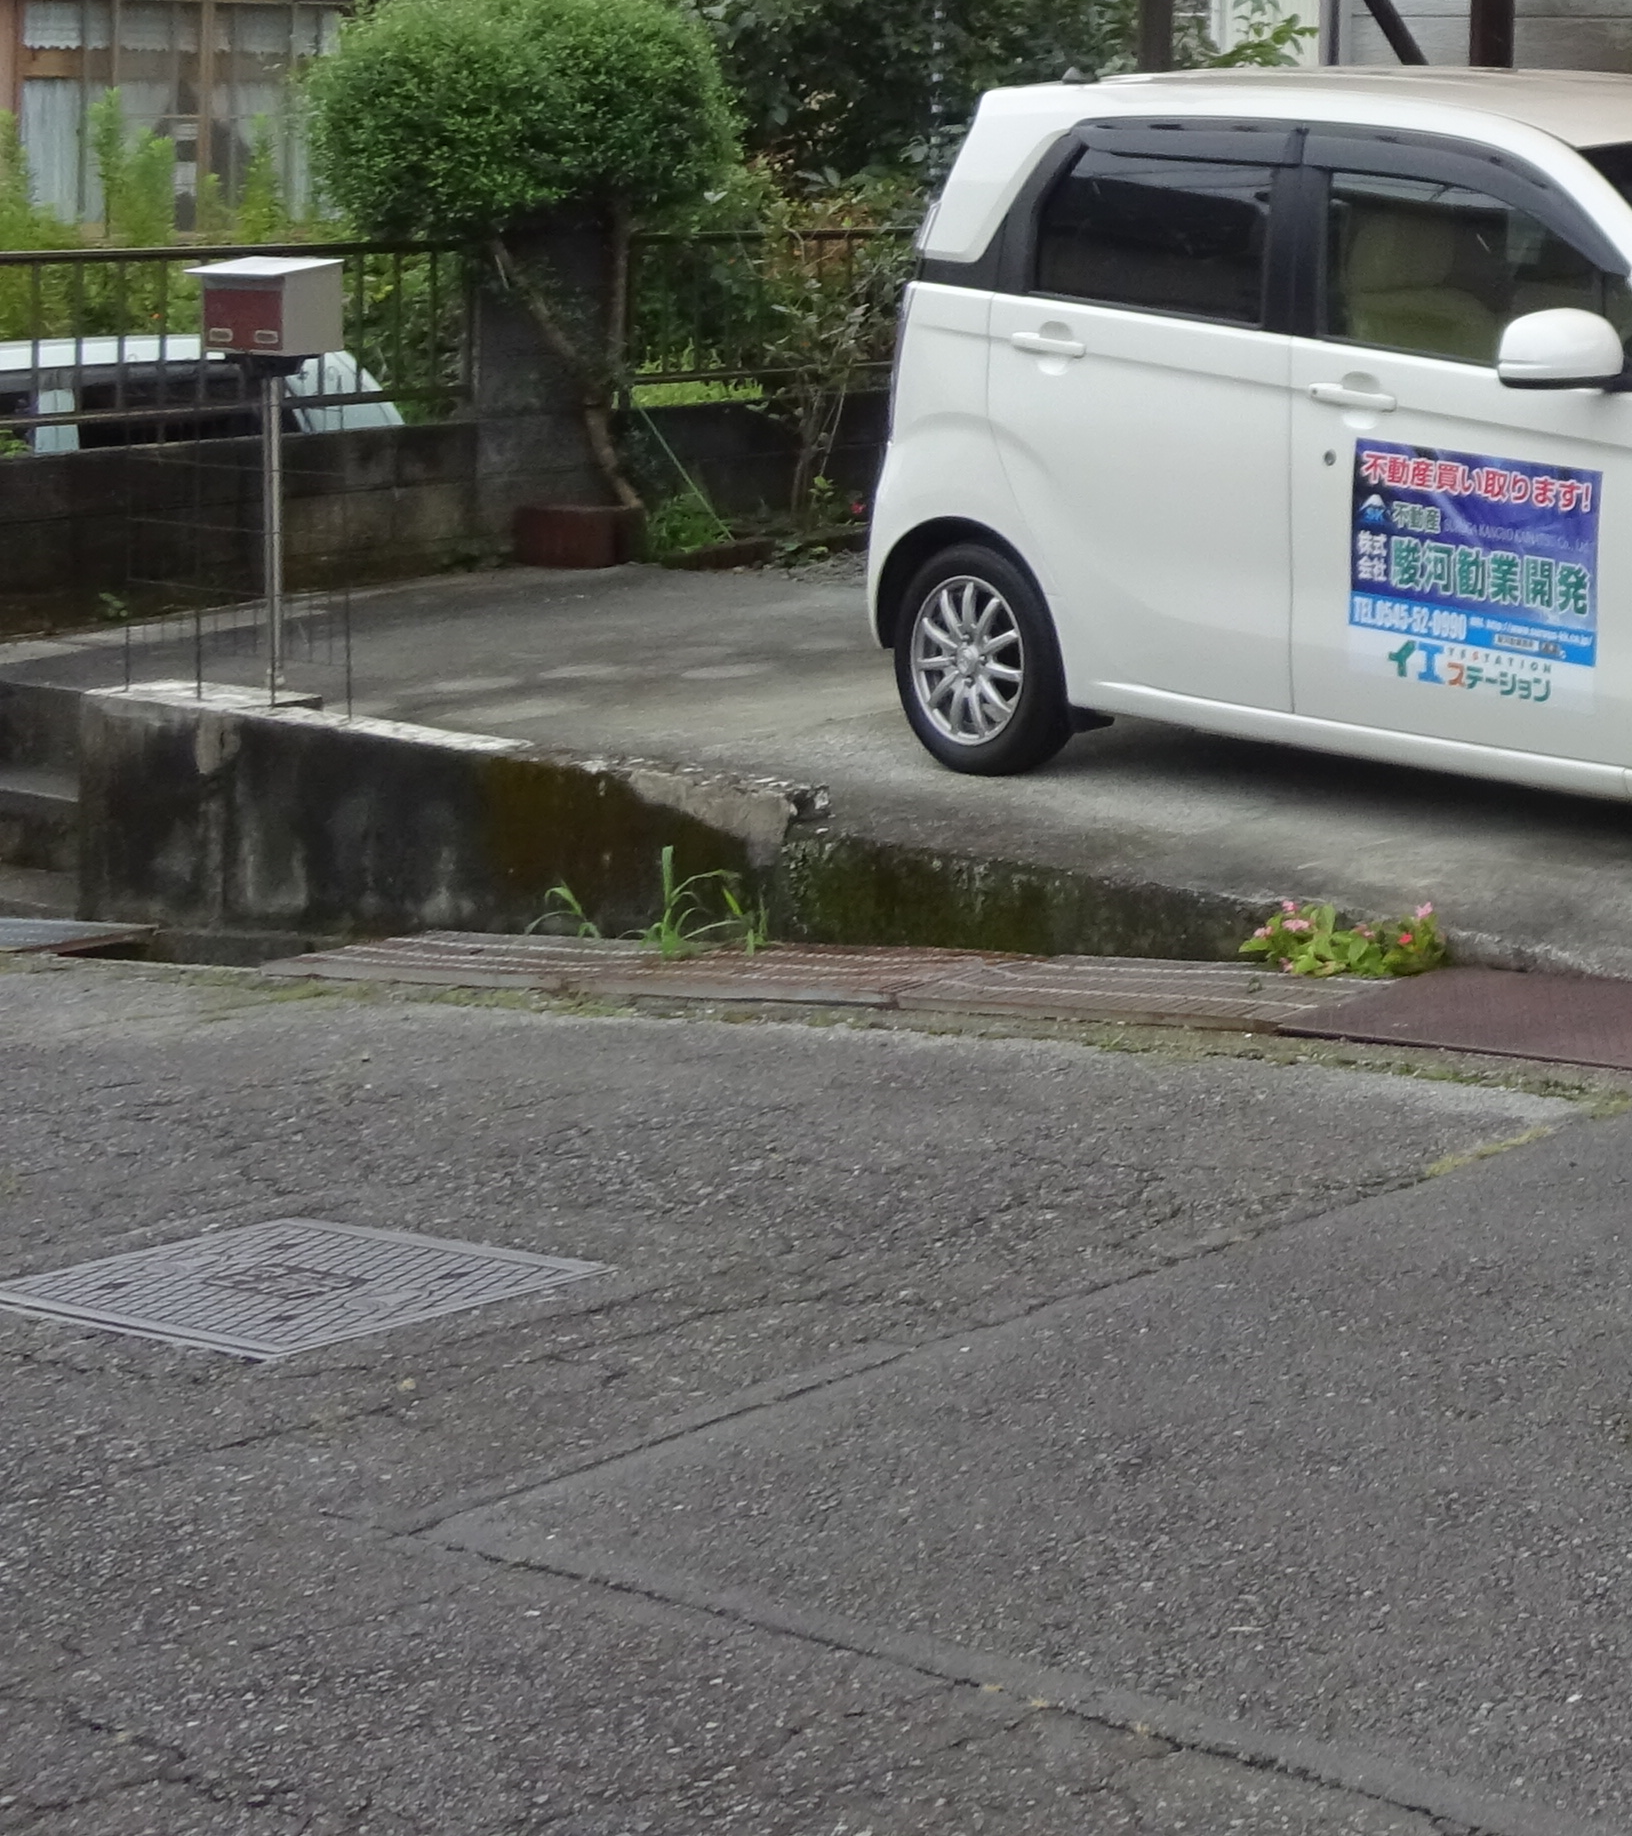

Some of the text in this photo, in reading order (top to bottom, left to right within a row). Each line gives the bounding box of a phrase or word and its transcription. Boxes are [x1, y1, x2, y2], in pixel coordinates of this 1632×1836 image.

[1361, 451, 1592, 513] 不動産買い取ります!
[1391, 501, 1441, 534] 不動産
[1390, 536, 1591, 617] 駿河勧業開発
